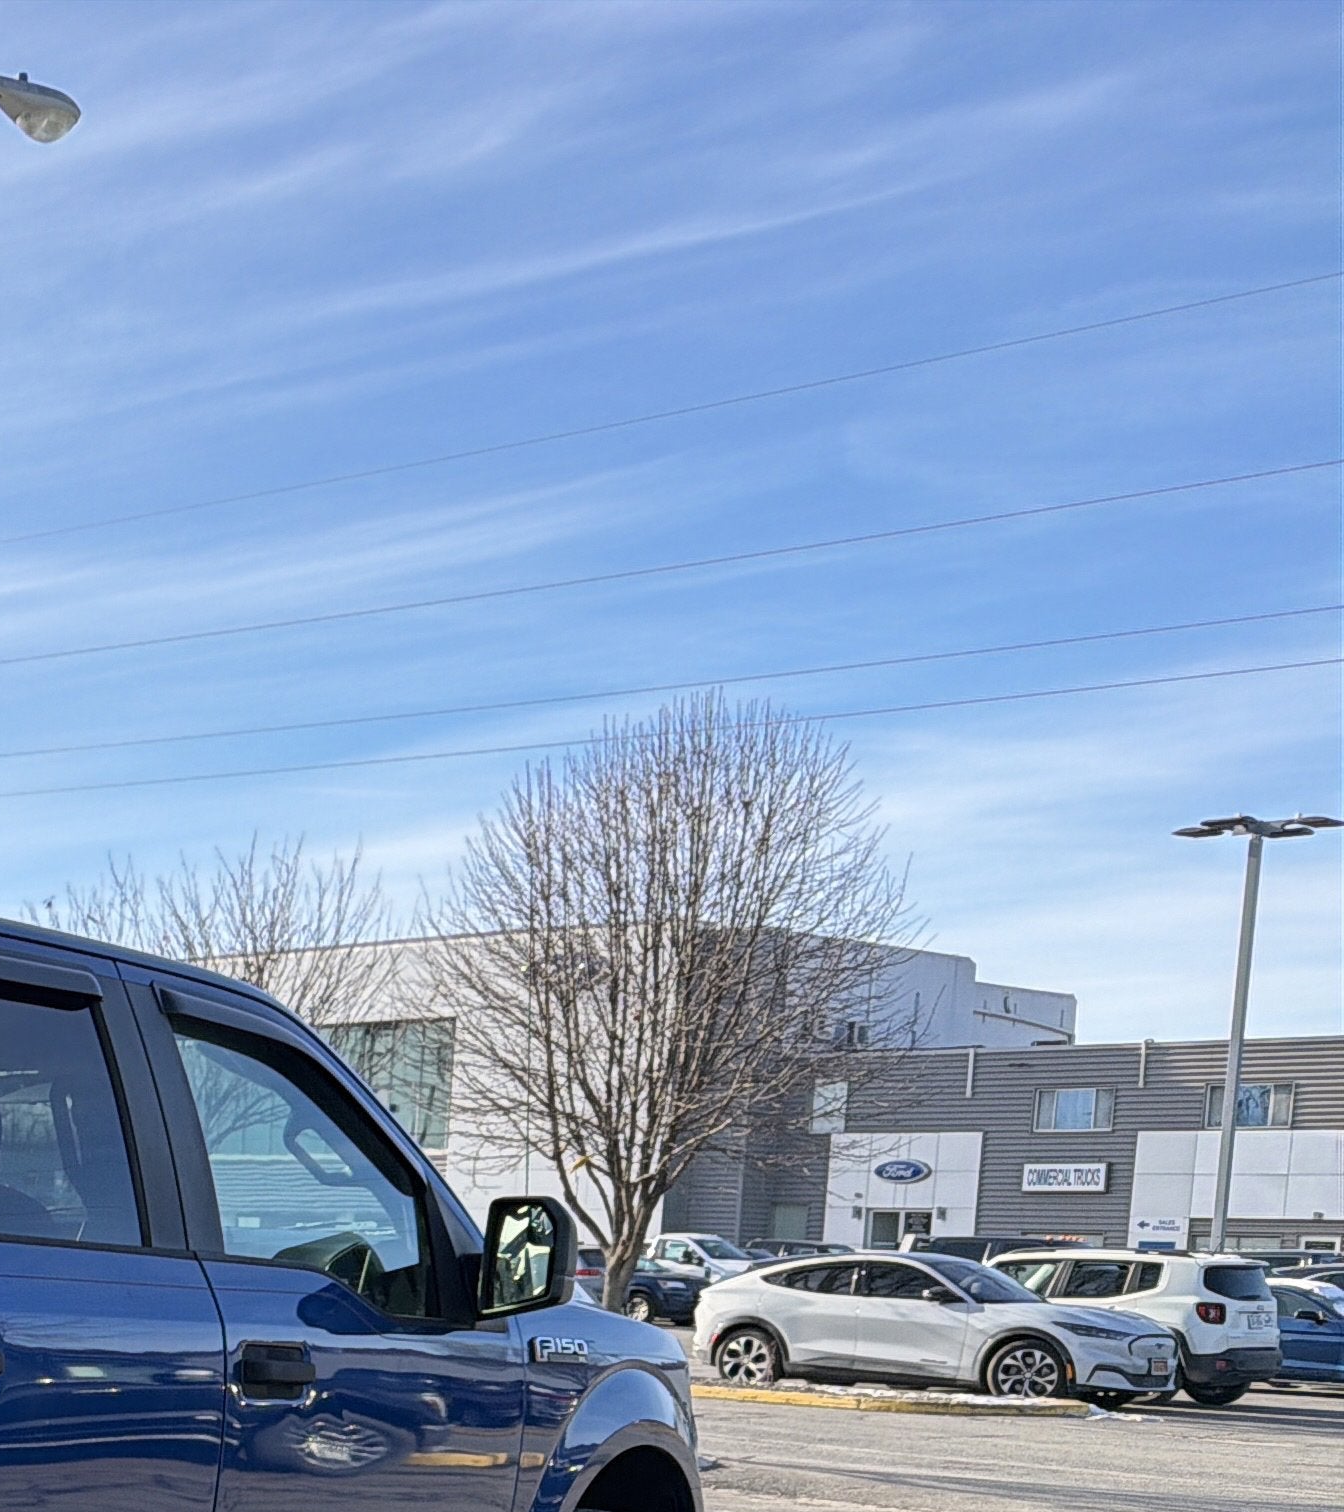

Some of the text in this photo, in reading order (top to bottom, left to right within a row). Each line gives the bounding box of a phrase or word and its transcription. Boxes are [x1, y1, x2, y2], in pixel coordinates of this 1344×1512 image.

[882, 1164, 916, 1178] Ford
[1027, 1168, 1101, 1186] COMMERCIAL TRUCKS
